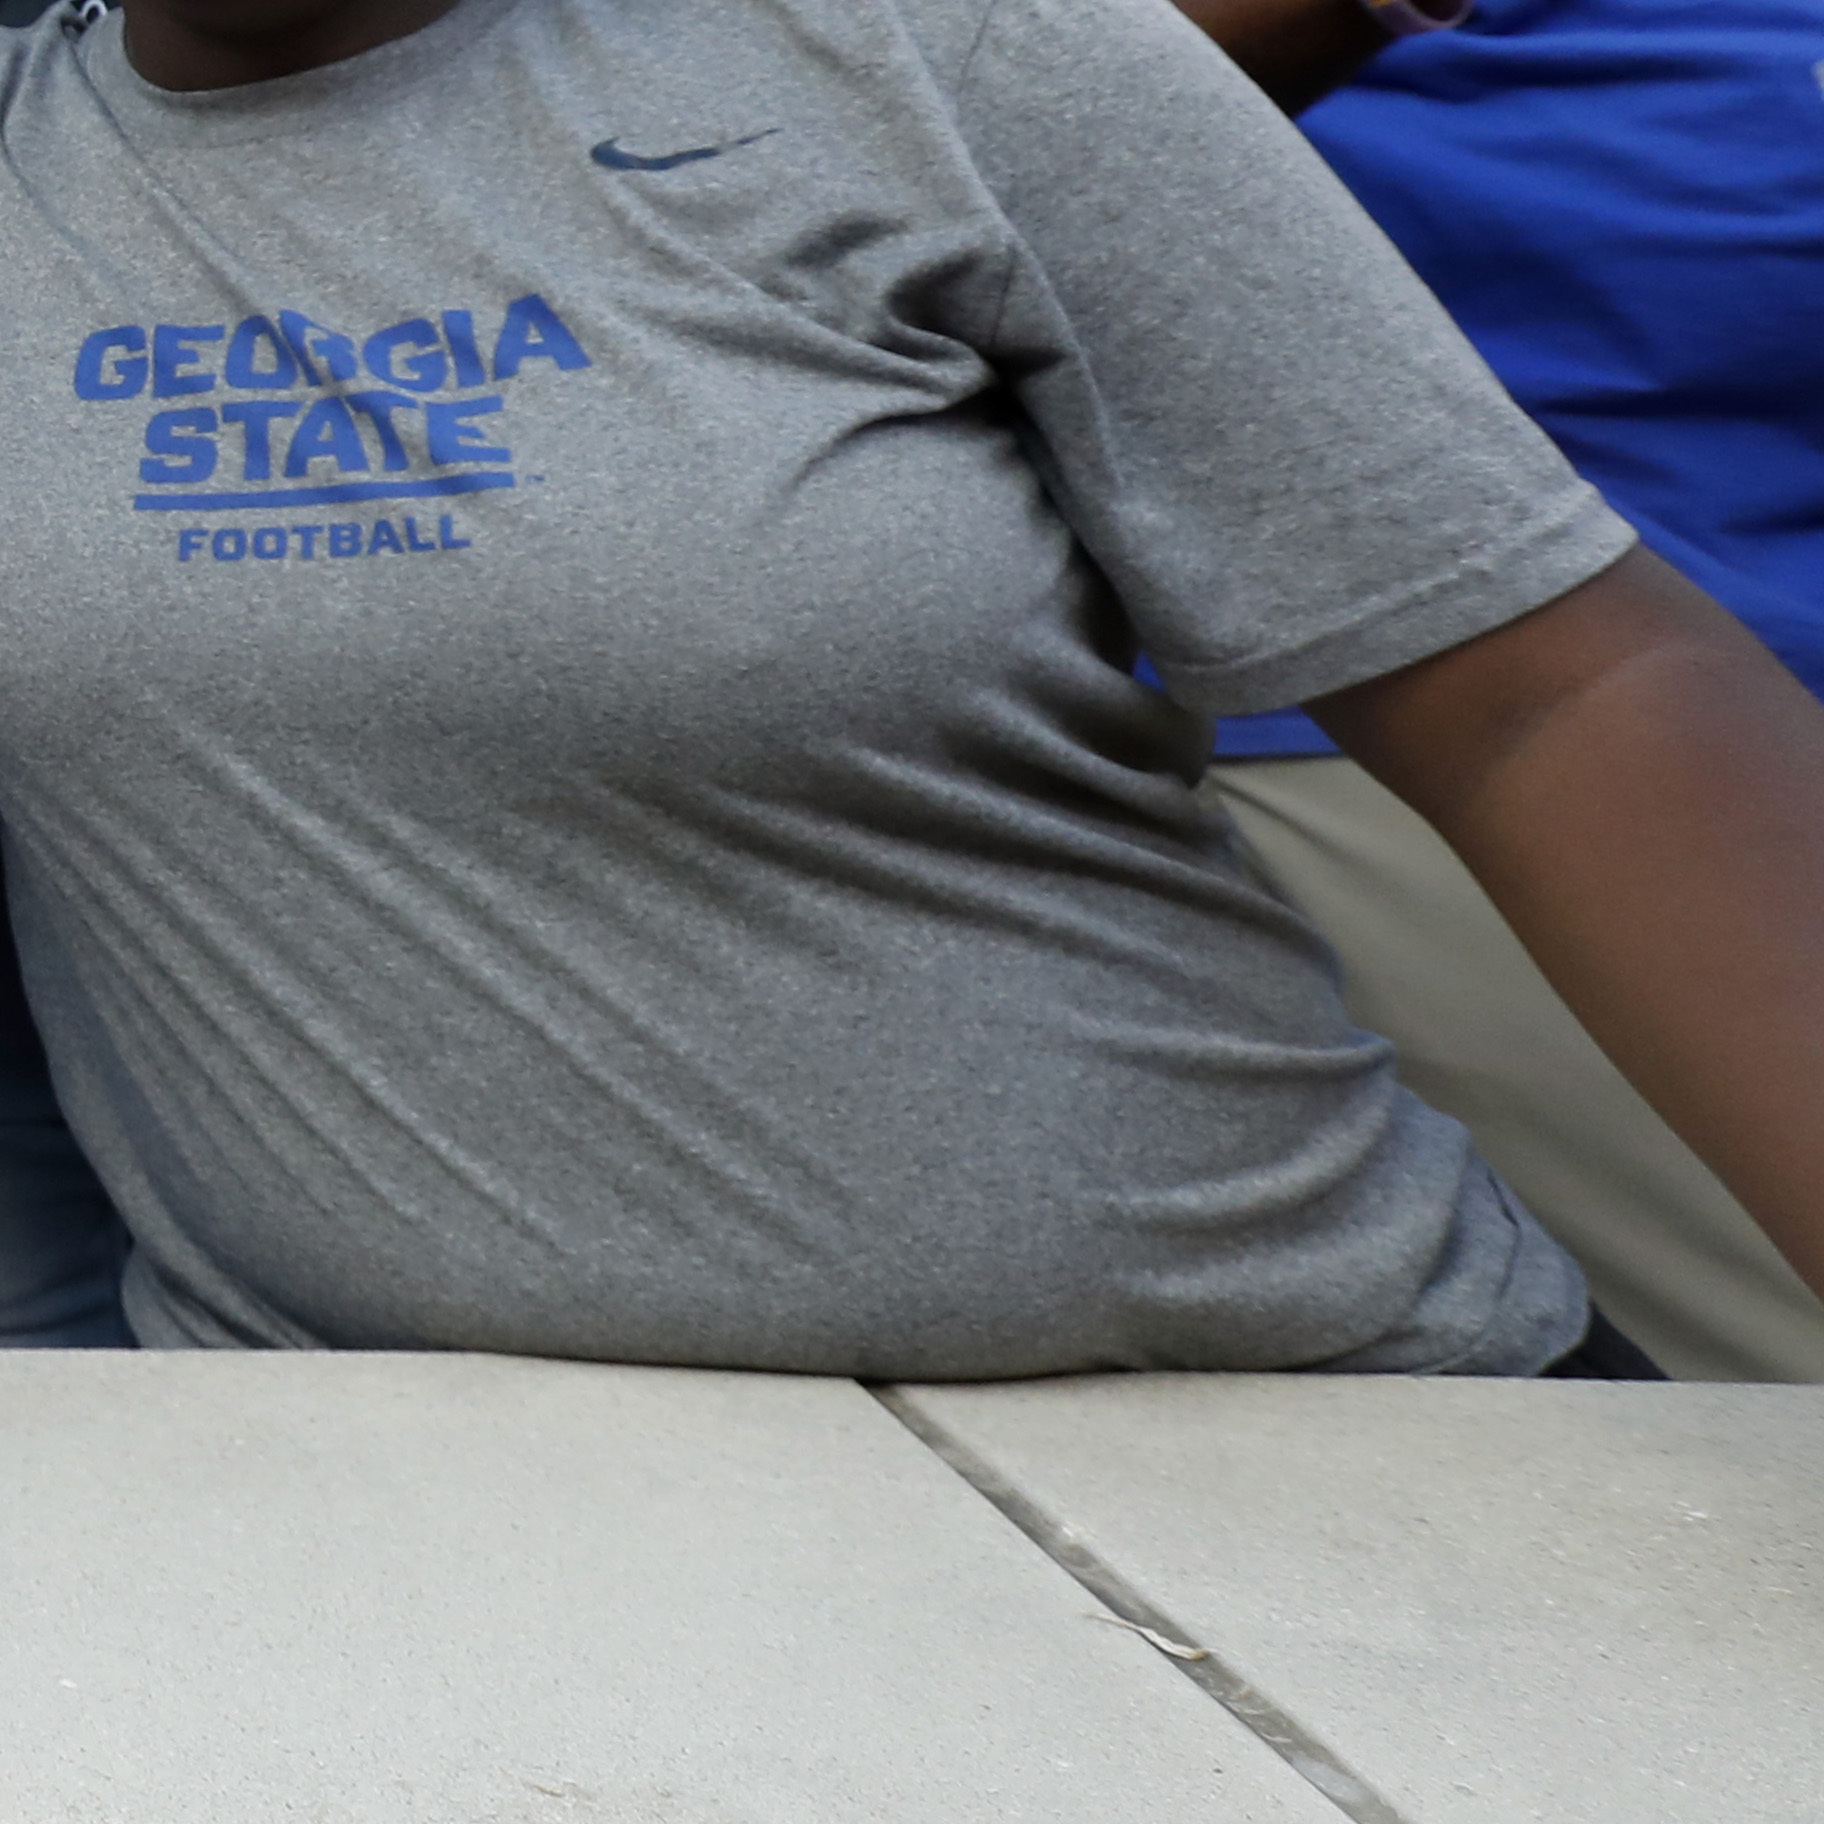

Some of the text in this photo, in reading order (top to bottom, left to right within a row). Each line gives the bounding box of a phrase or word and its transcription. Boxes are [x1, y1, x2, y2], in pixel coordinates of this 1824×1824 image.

[73, 292, 593, 402] GEORGIA
[138, 394, 512, 485] STATE
[178, 513, 472, 563] FOOTBALL
